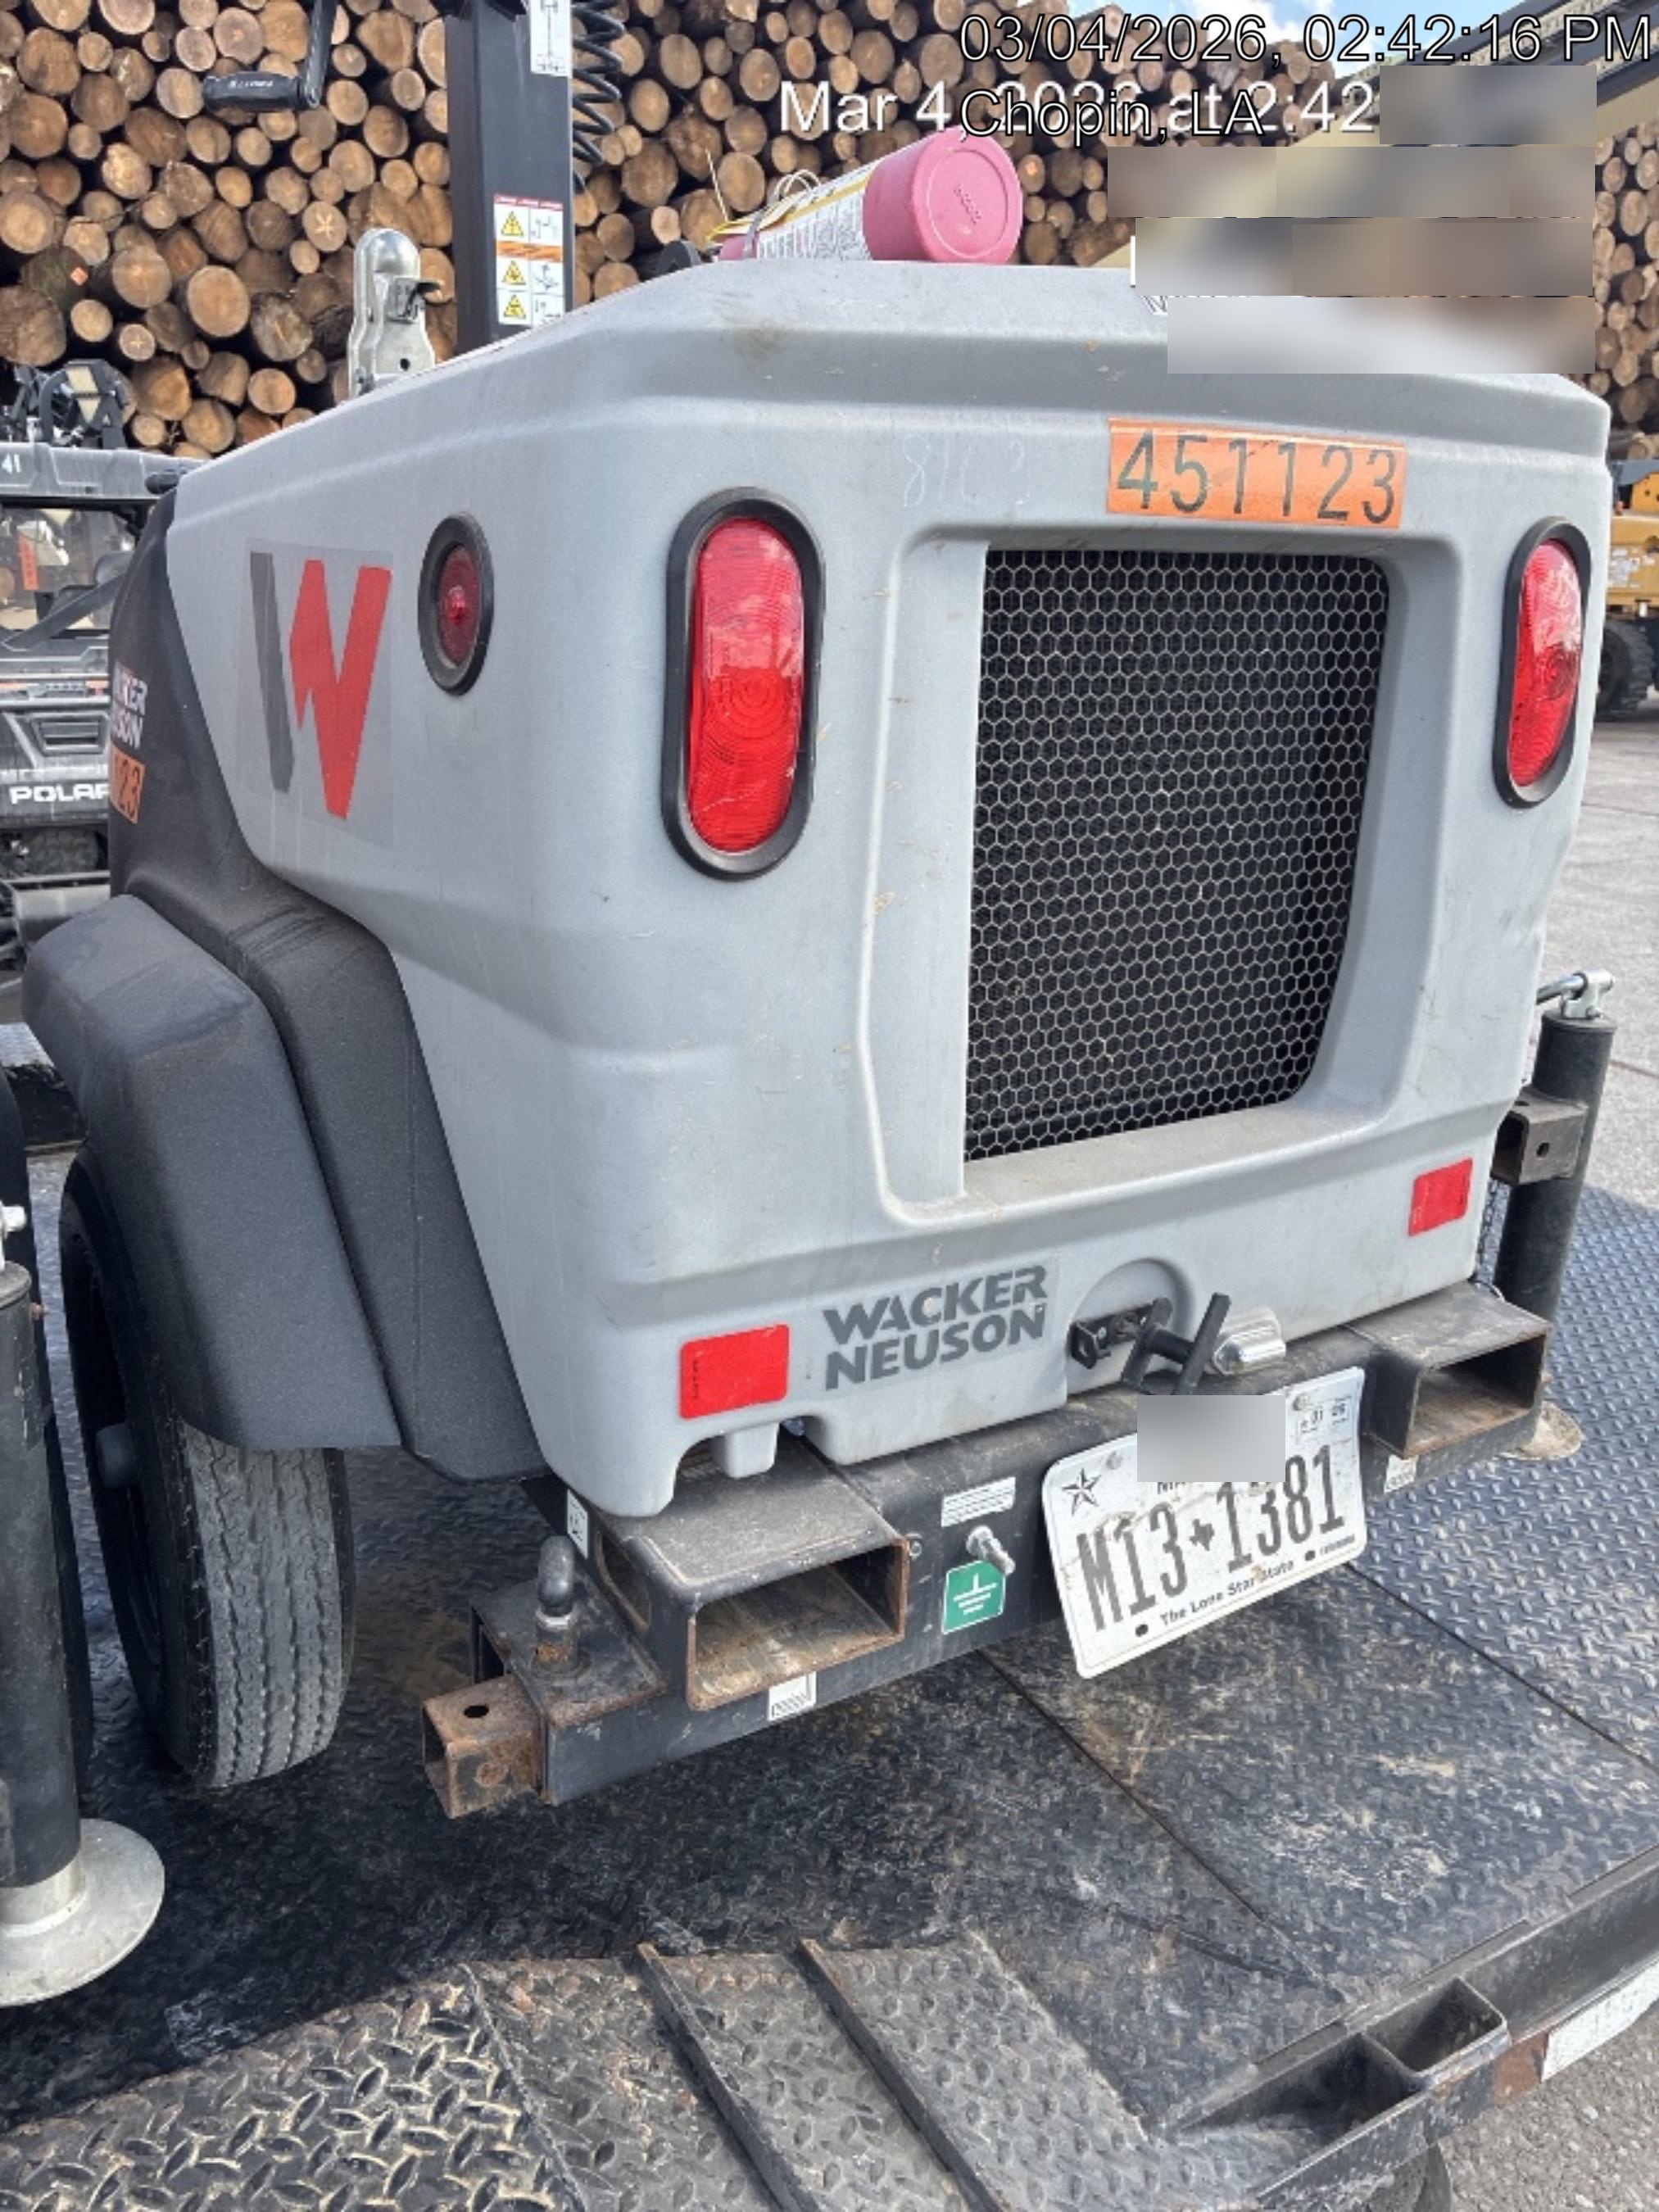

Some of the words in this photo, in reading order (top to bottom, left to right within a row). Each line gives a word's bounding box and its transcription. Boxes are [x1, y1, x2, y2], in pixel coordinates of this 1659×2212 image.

[1117, 431, 1396, 524] 451123
[823, 1265, 1048, 1345] WACKER
[826, 1303, 1048, 1392] NEUSON
